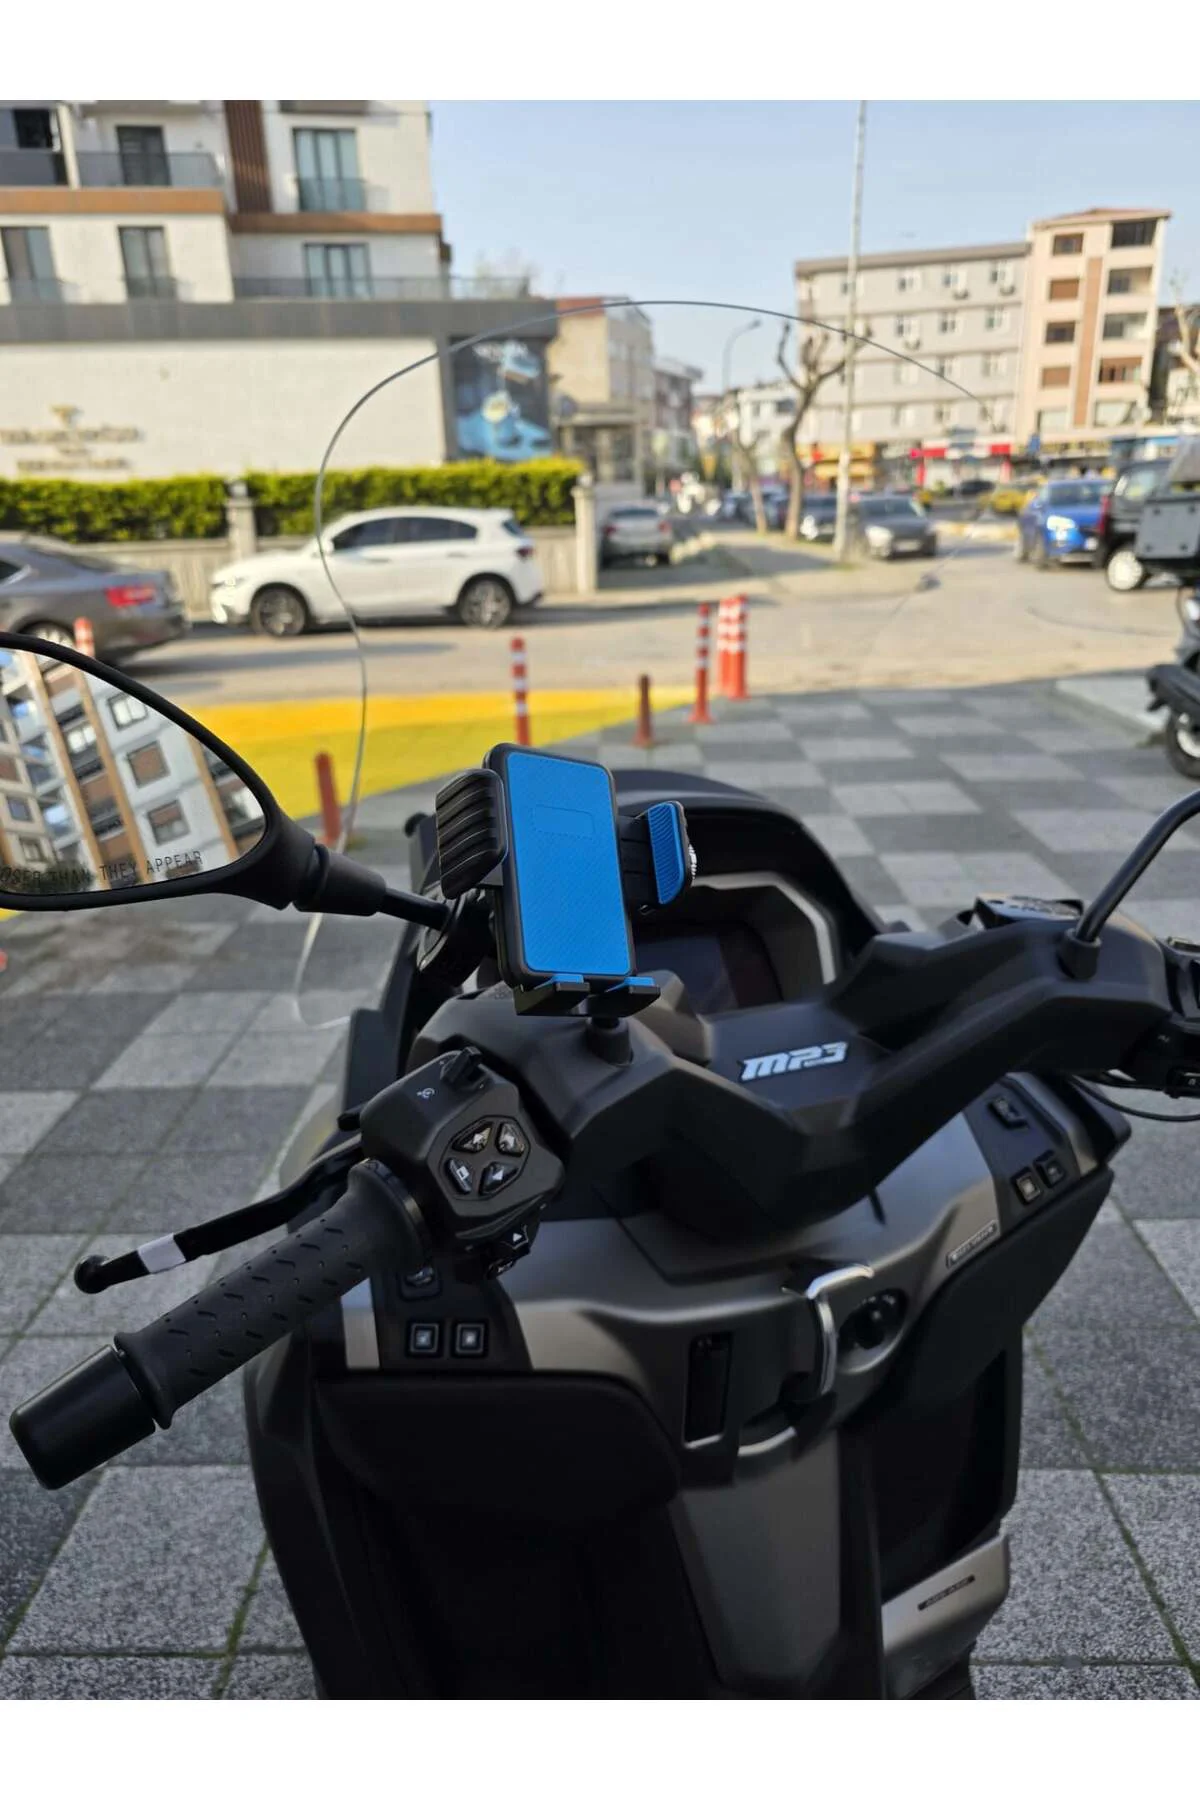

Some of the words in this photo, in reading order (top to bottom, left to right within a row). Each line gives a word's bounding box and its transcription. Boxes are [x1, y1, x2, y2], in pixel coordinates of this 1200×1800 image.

[46, 867, 91, 887] THAN
[99, 860, 138, 881] THEY
[147, 850, 203, 875] APPEAR
[740, 1041, 848, 1081] MP3
